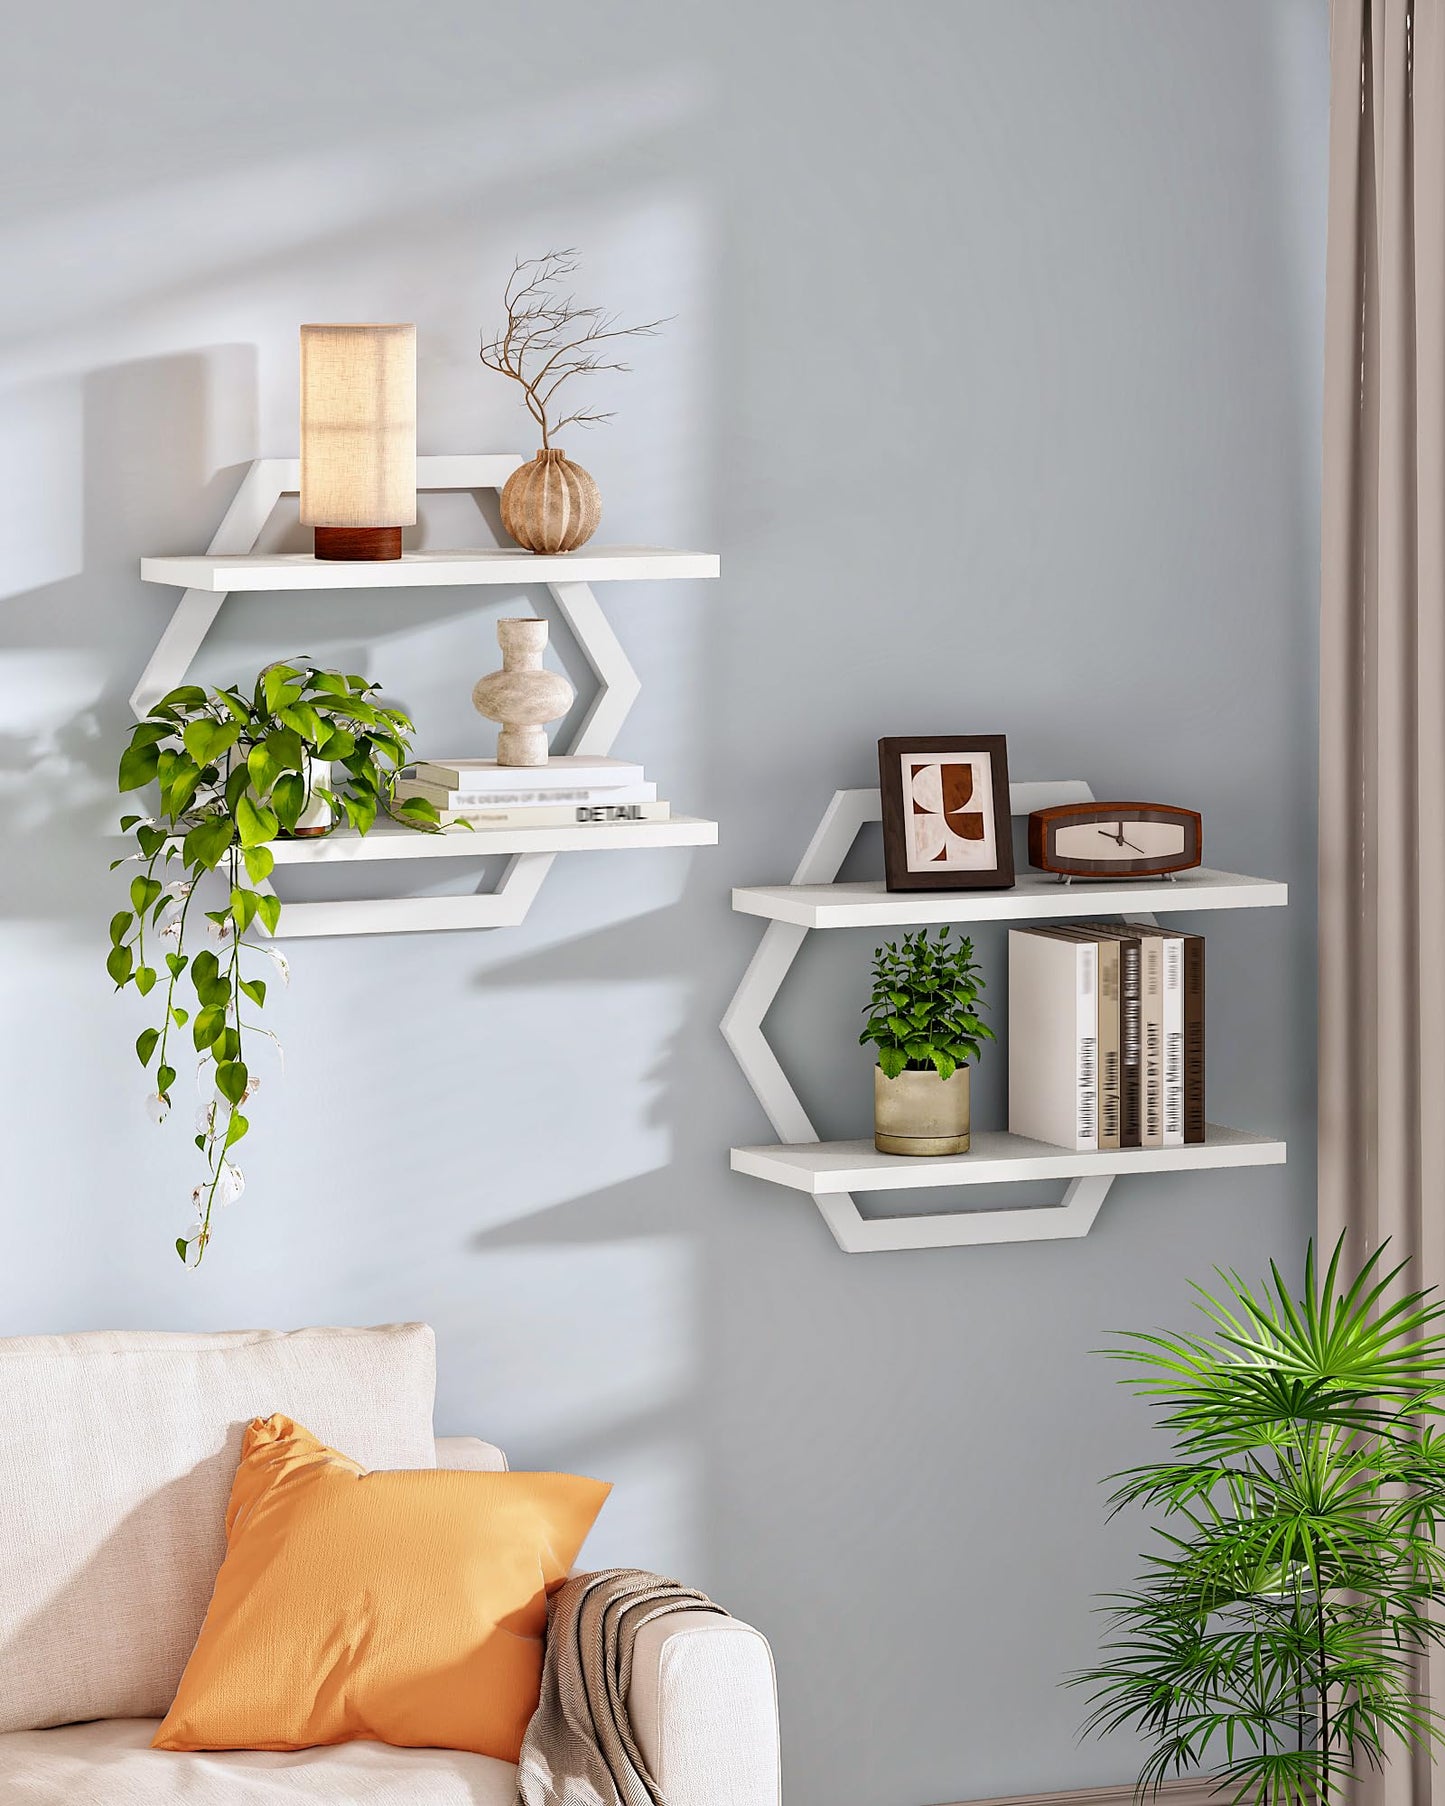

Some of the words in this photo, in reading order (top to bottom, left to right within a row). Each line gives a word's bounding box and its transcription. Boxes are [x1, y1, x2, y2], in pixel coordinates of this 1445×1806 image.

[576, 805, 648, 822] DETAIL
[1124, 948, 1138, 997] Sciences
[1124, 1000, 1140, 1065] Engineering
[1147, 1021, 1160, 1057] LIGHT
[1079, 1037, 1096, 1087] Meaning
[1103, 1051, 1117, 1090] Homes
[1147, 1060, 1160, 1077] BY
[1166, 1033, 1182, 1082] Meaning
[1079, 1091, 1096, 1137] Building
[1103, 1093, 1120, 1136] Healthy
[1147, 1080, 1160, 1136] INSPIRED
[1166, 1086, 1182, 1132] Building
